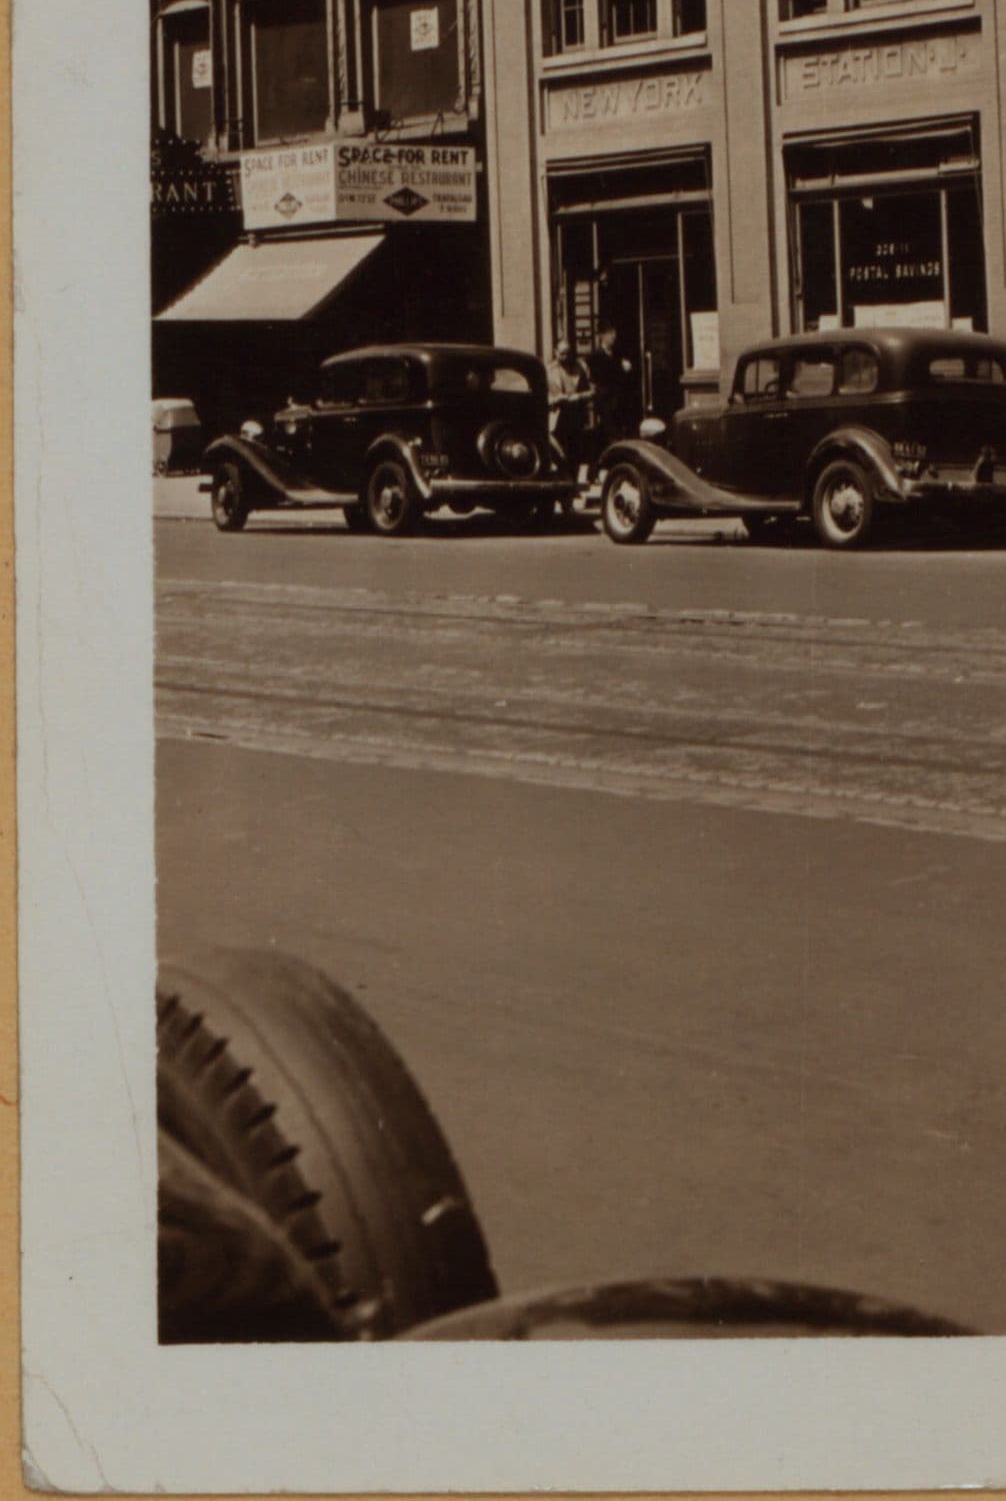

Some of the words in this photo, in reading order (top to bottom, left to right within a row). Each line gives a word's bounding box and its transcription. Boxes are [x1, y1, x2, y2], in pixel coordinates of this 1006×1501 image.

[802, 42, 928, 89] STATION
[562, 83, 622, 123] NEW
[630, 73, 704, 113] YORK
[244, 156, 273, 179] SPACE
[302, 148, 330, 166] RENT
[397, 148, 426, 165] FOR
[431, 150, 469, 165] RENT
[338, 169, 394, 187] CHINESE
[400, 171, 473, 187] RESTAURANT
[849, 265, 889, 281] POSTAL
[895, 261, 940, 279] SAVINGS
